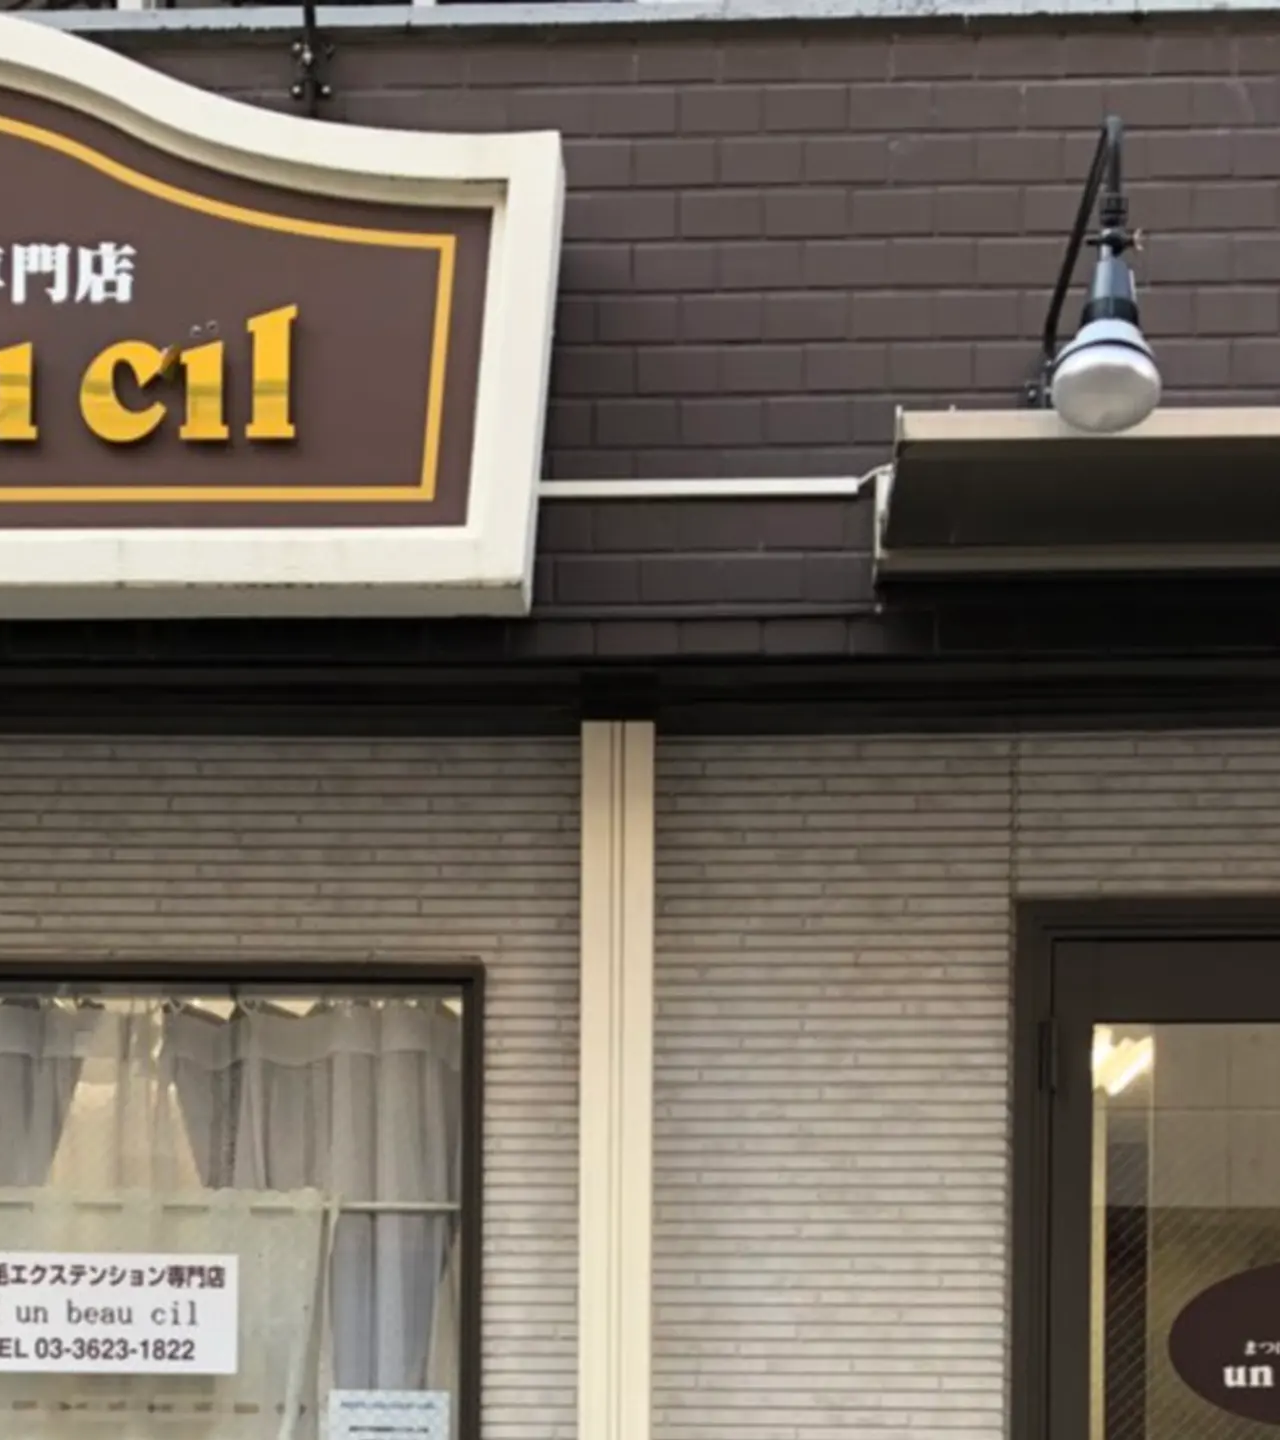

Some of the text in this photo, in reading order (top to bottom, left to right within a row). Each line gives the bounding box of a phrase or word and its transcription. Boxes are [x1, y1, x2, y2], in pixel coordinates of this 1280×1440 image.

[15, 1304, 48, 1324] un
[66, 1299, 133, 1325] beau
[150, 1300, 199, 1327] cil
[34, 1337, 195, 1361] 03-3623-1822
[1223, 1364, 1274, 1388] un
